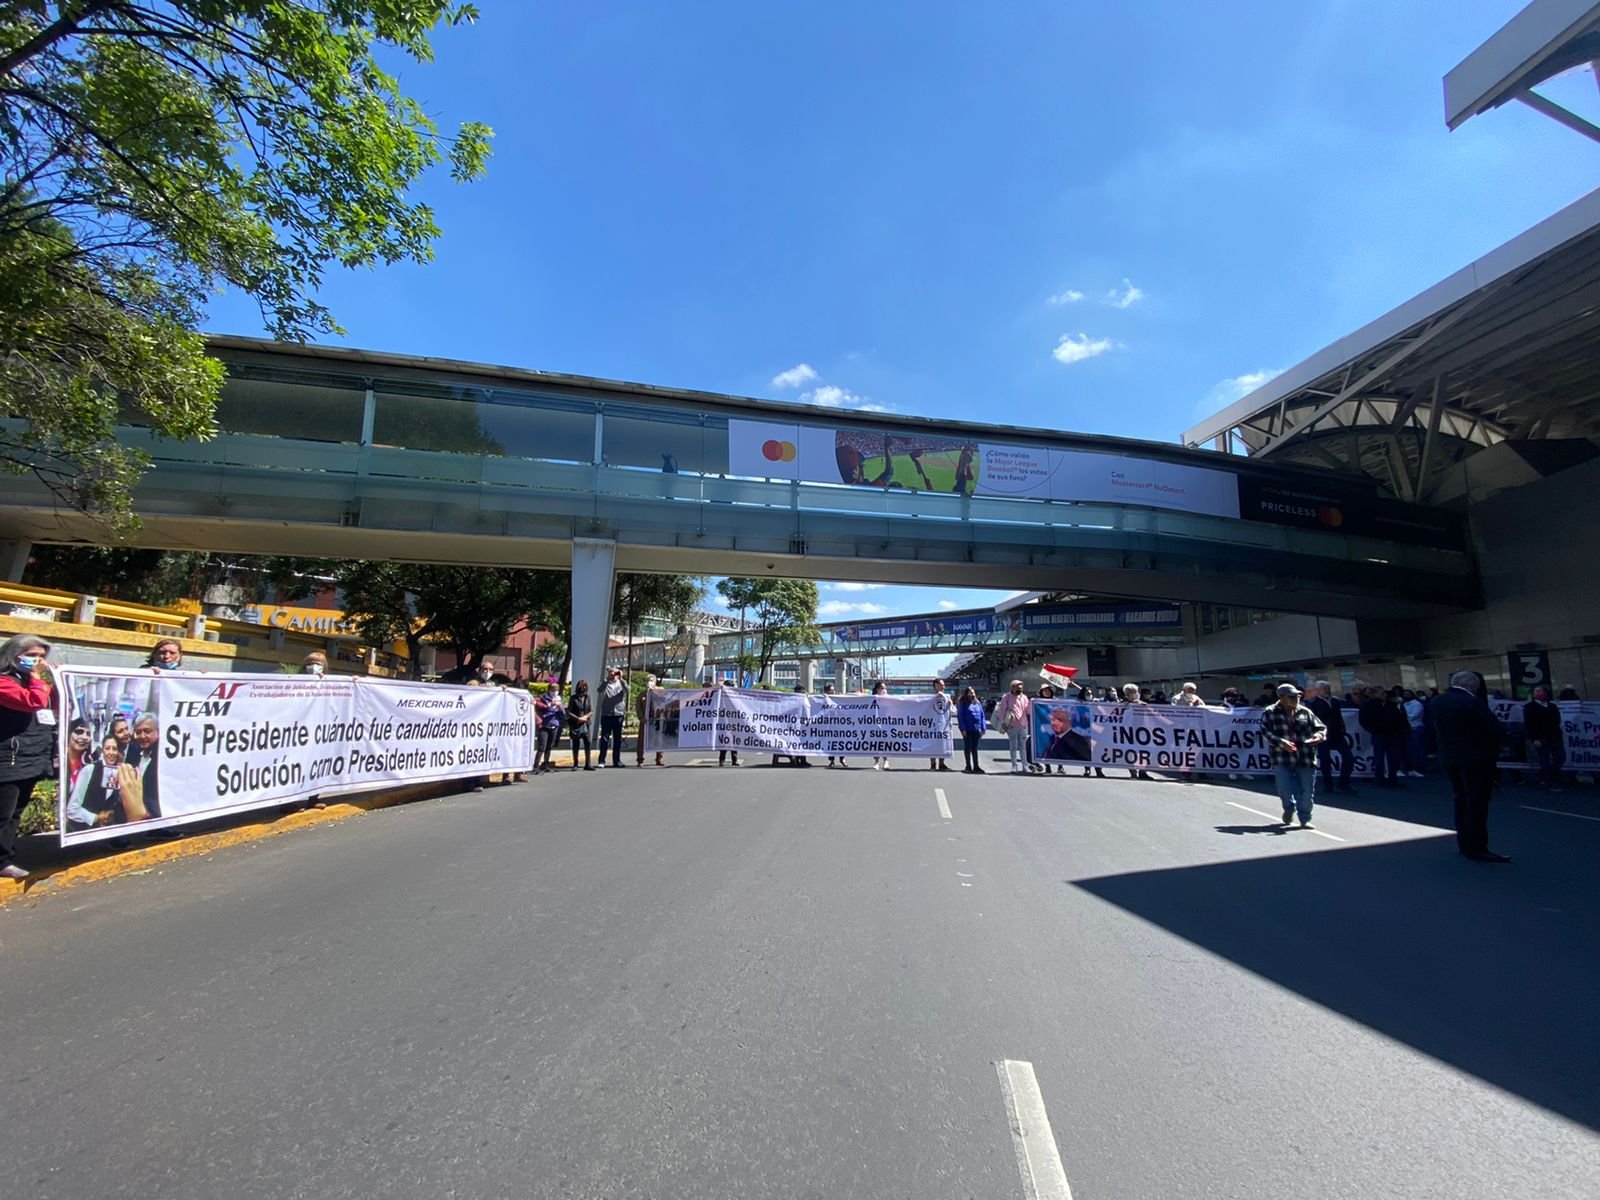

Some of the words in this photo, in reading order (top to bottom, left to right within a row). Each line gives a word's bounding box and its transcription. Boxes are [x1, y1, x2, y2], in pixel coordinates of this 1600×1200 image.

[1111, 471, 1125, 479] Con
[1261, 501, 1317, 517] PRICELESS
[1520, 656, 1544, 684] 3
[174, 701, 231, 717] TEAM
[397, 699, 453, 709] MEXICANA
[800, 715, 855, 726] ayudarnos,
[858, 715, 904, 725] violentan
[907, 716, 916, 726] la
[919, 716, 936, 728] ley,
[1093, 715, 1124, 723] TEAM
[1564, 721, 1580, 733] Sr.
[165, 724, 193, 759] Sr.
[202, 721, 308, 755] Presidente
[315, 715, 363, 744] cuándo
[369, 716, 393, 741] fué
[395, 718, 457, 740] candidato
[462, 722, 483, 738] nos
[683, 722, 712, 732] violan
[760, 725, 807, 737] Derechos
[810, 728, 857, 738] Humanos
[860, 730, 867, 740] y
[870, 730, 888, 738] sus
[1112, 726, 1166, 746] ¡NOS
[733, 735, 741, 745] le
[744, 736, 771, 748] dicen
[775, 737, 783, 748] la
[787, 738, 823, 750] verdad.
[828, 737, 912, 752] ¡ESCÚCHENOS!
[1101, 748, 1150, 765] ¿POR
[1157, 747, 1196, 768] QUÉ
[1202, 753, 1240, 769] NOS
[216, 755, 305, 796] Solución,
[348, 748, 426, 773] Presidente
[430, 752, 454, 768] nos
